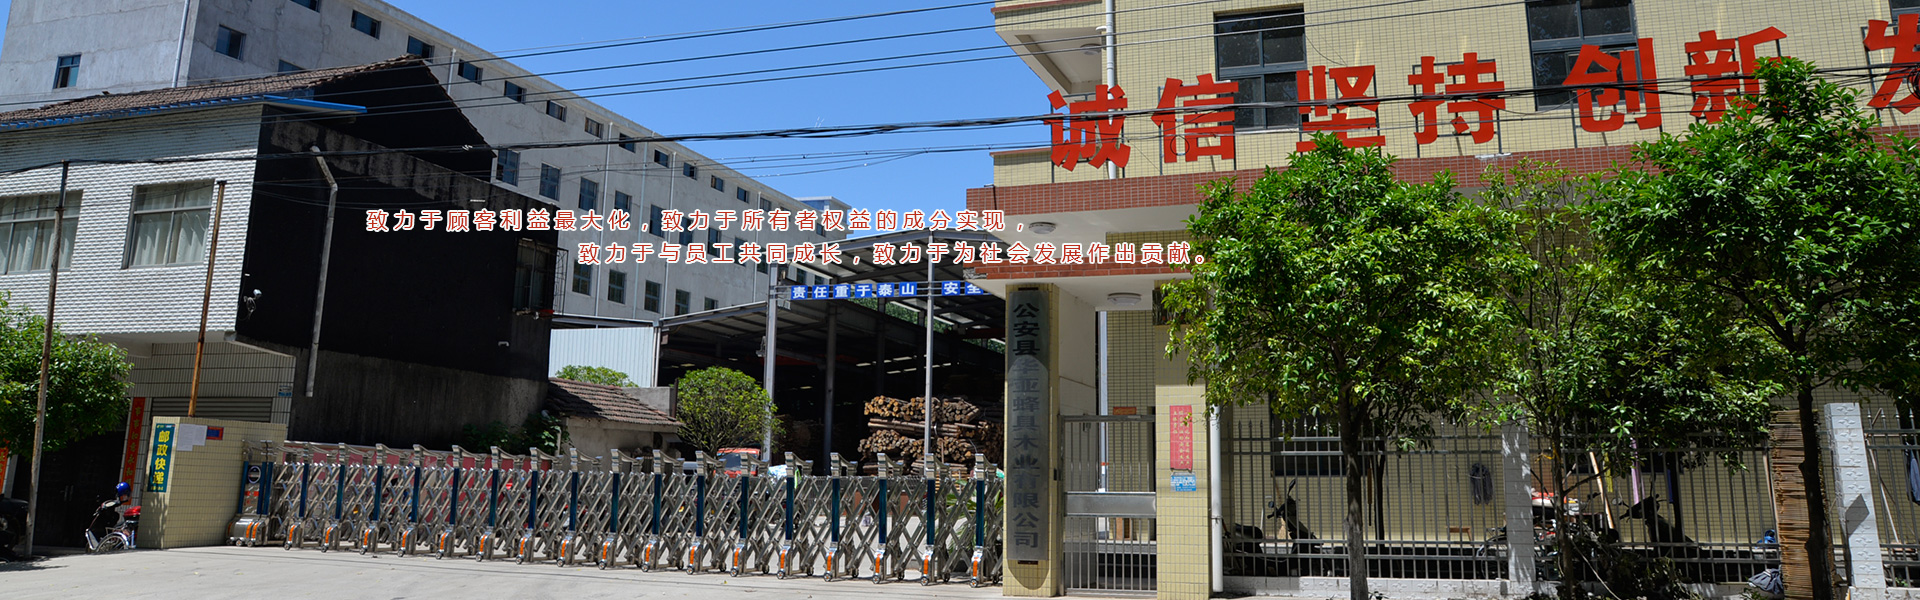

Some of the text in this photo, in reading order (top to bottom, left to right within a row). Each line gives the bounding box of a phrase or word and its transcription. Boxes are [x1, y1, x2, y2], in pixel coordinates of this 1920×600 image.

[1046, 73, 1239, 172] 诚信
[1296, 52, 1506, 154] 坚持
[1560, 26, 1788, 133] 创新
[792, 283, 915, 299] 责任重于泰山
[153, 430, 170, 484] 邮政快递
